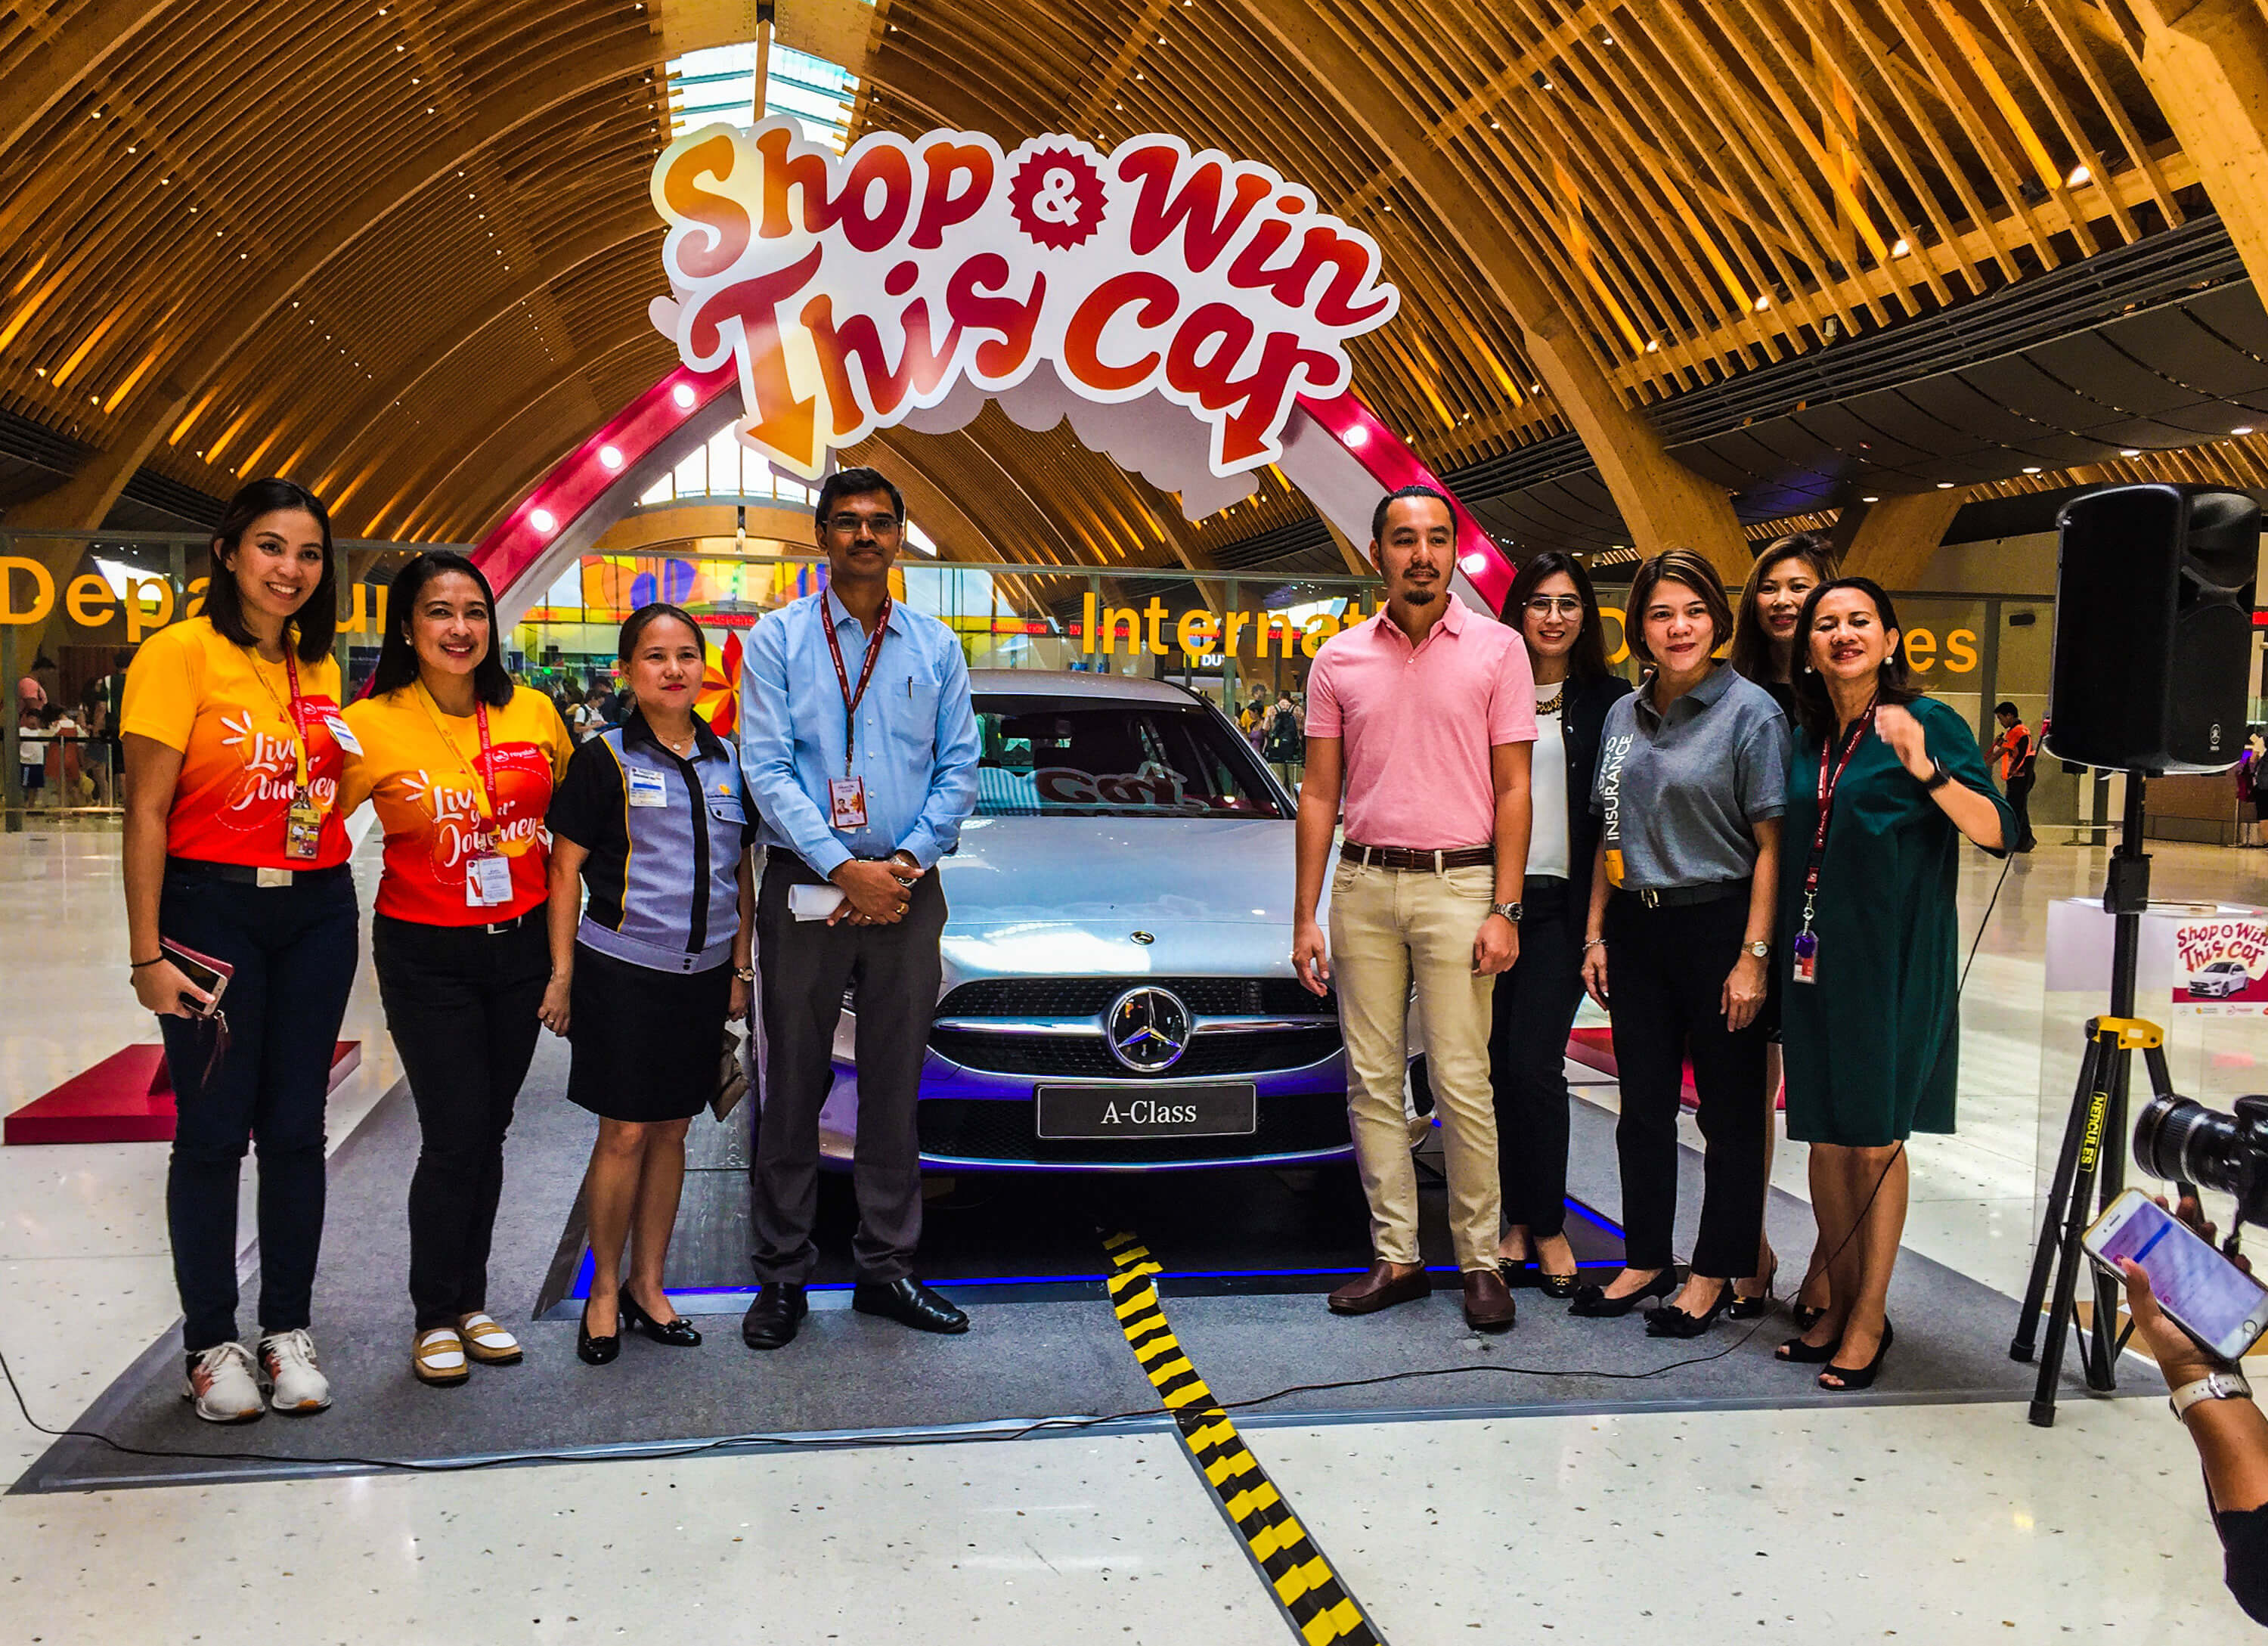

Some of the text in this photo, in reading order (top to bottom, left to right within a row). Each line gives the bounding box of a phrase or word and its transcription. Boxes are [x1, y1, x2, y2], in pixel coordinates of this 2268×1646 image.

[663, 126, 1390, 327] Shop & Win
[690, 240, 1340, 467] This Car
[1603, 733, 1634, 841] INSURANCE
[2177, 925, 2219, 948] Shop
[2179, 940, 2265, 972] This Car
[1101, 1100, 1197, 1124] A-Class
